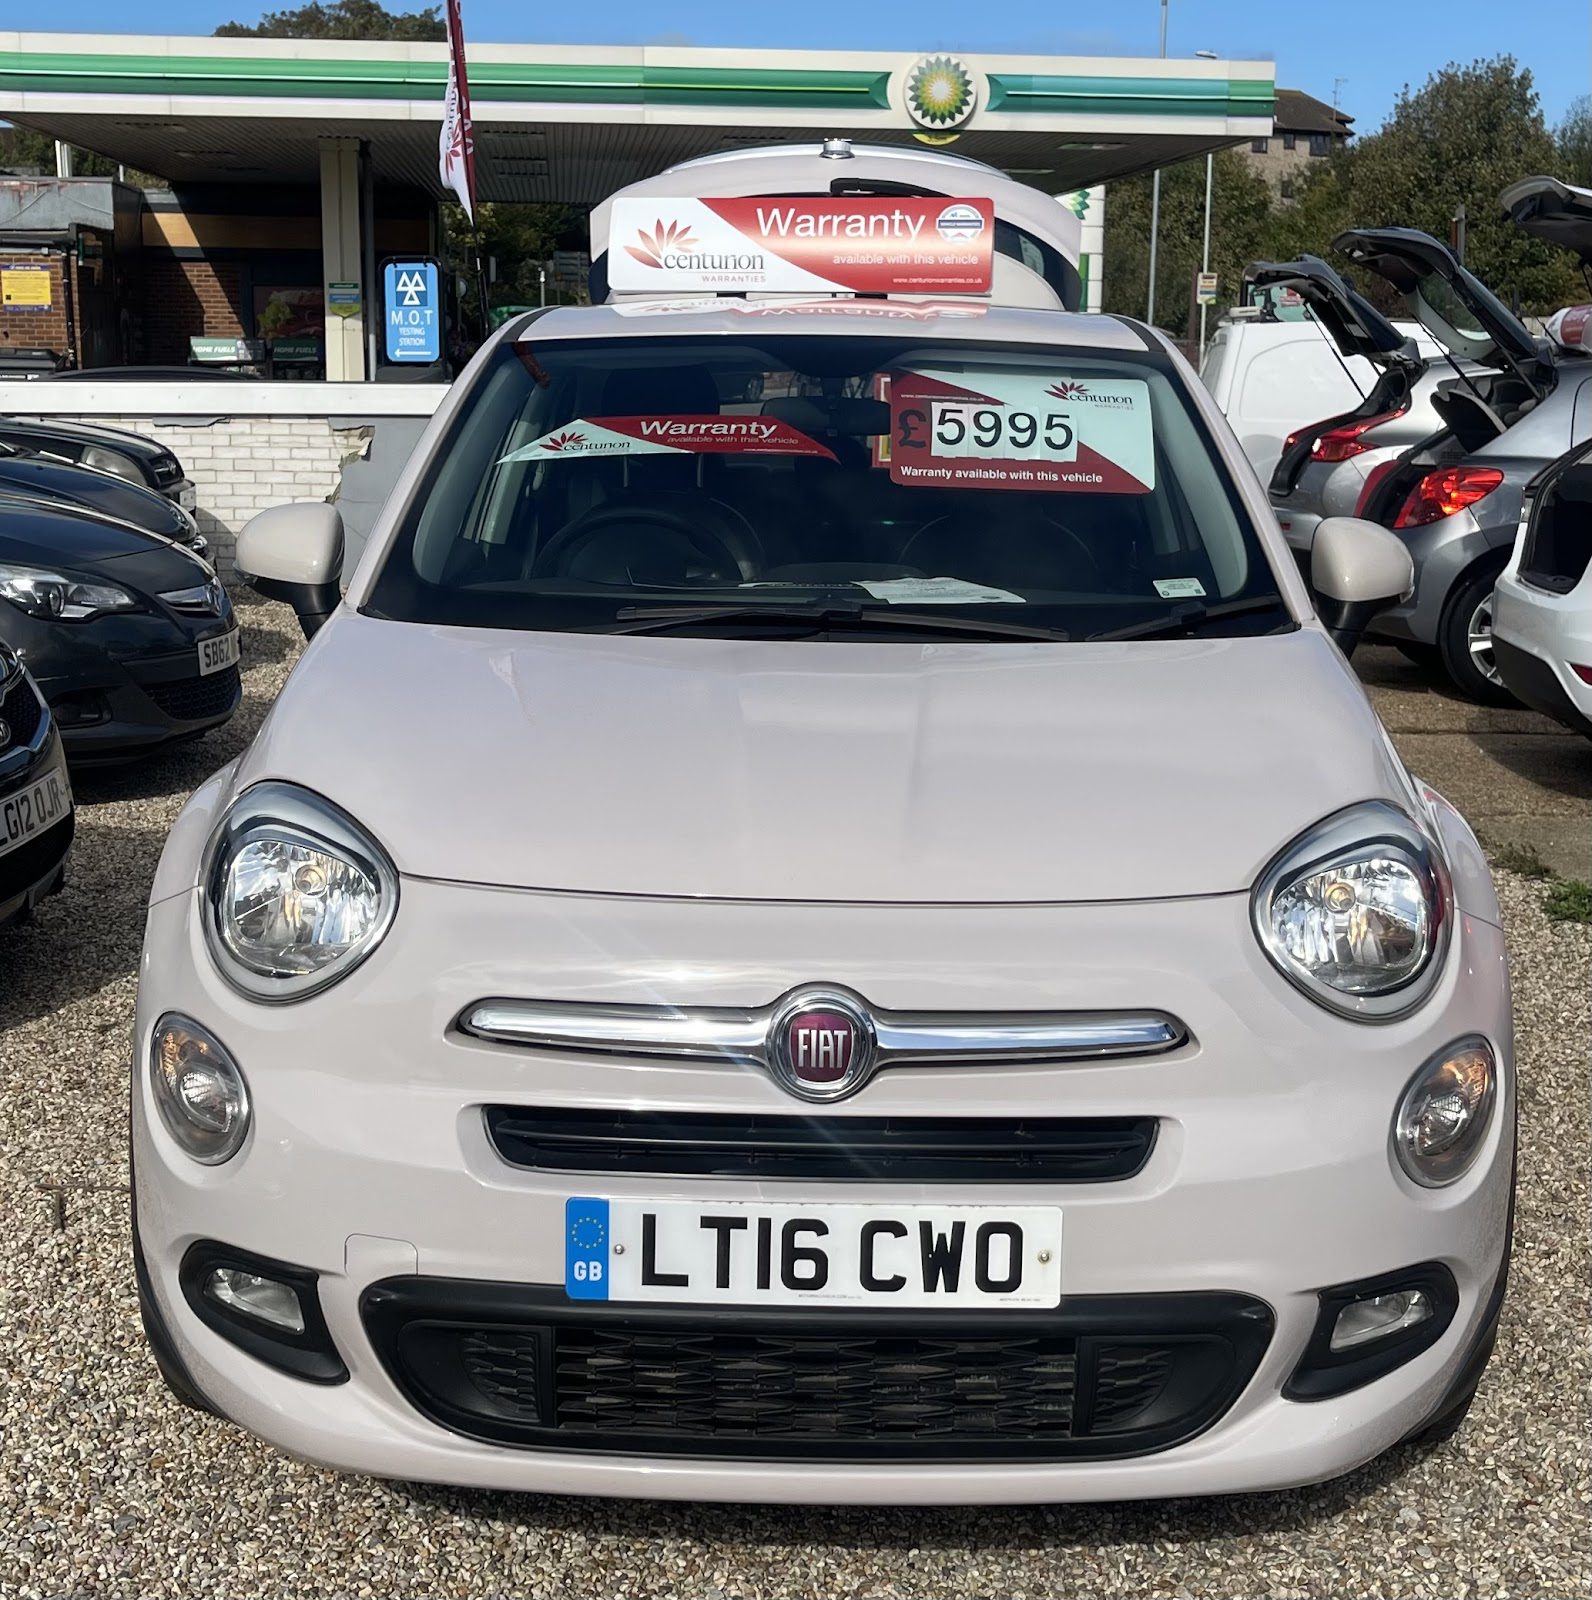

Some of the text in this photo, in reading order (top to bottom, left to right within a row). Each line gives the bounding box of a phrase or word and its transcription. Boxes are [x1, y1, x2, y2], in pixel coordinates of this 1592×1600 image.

[756, 207, 926, 243] Warranty
[664, 252, 765, 270] centurion
[833, 254, 979, 265] available with this vehicle
[701, 275, 767, 283] WARRANTIES
[391, 310, 433, 325] M.O.T
[399, 327, 426, 336] TESTING
[399, 337, 426, 346] STATION
[640, 420, 778, 438] Warranty
[667, 435, 713, 443] available
[900, 466, 1103, 483] Warranty available with this vehicle
[204, 637, 230, 668] SB62
[0, 794, 35, 846] G12
[798, 1028, 848, 1068] FIAT
[642, 1213, 1024, 1293] LT16 CWO
[573, 1260, 603, 1282] GB
